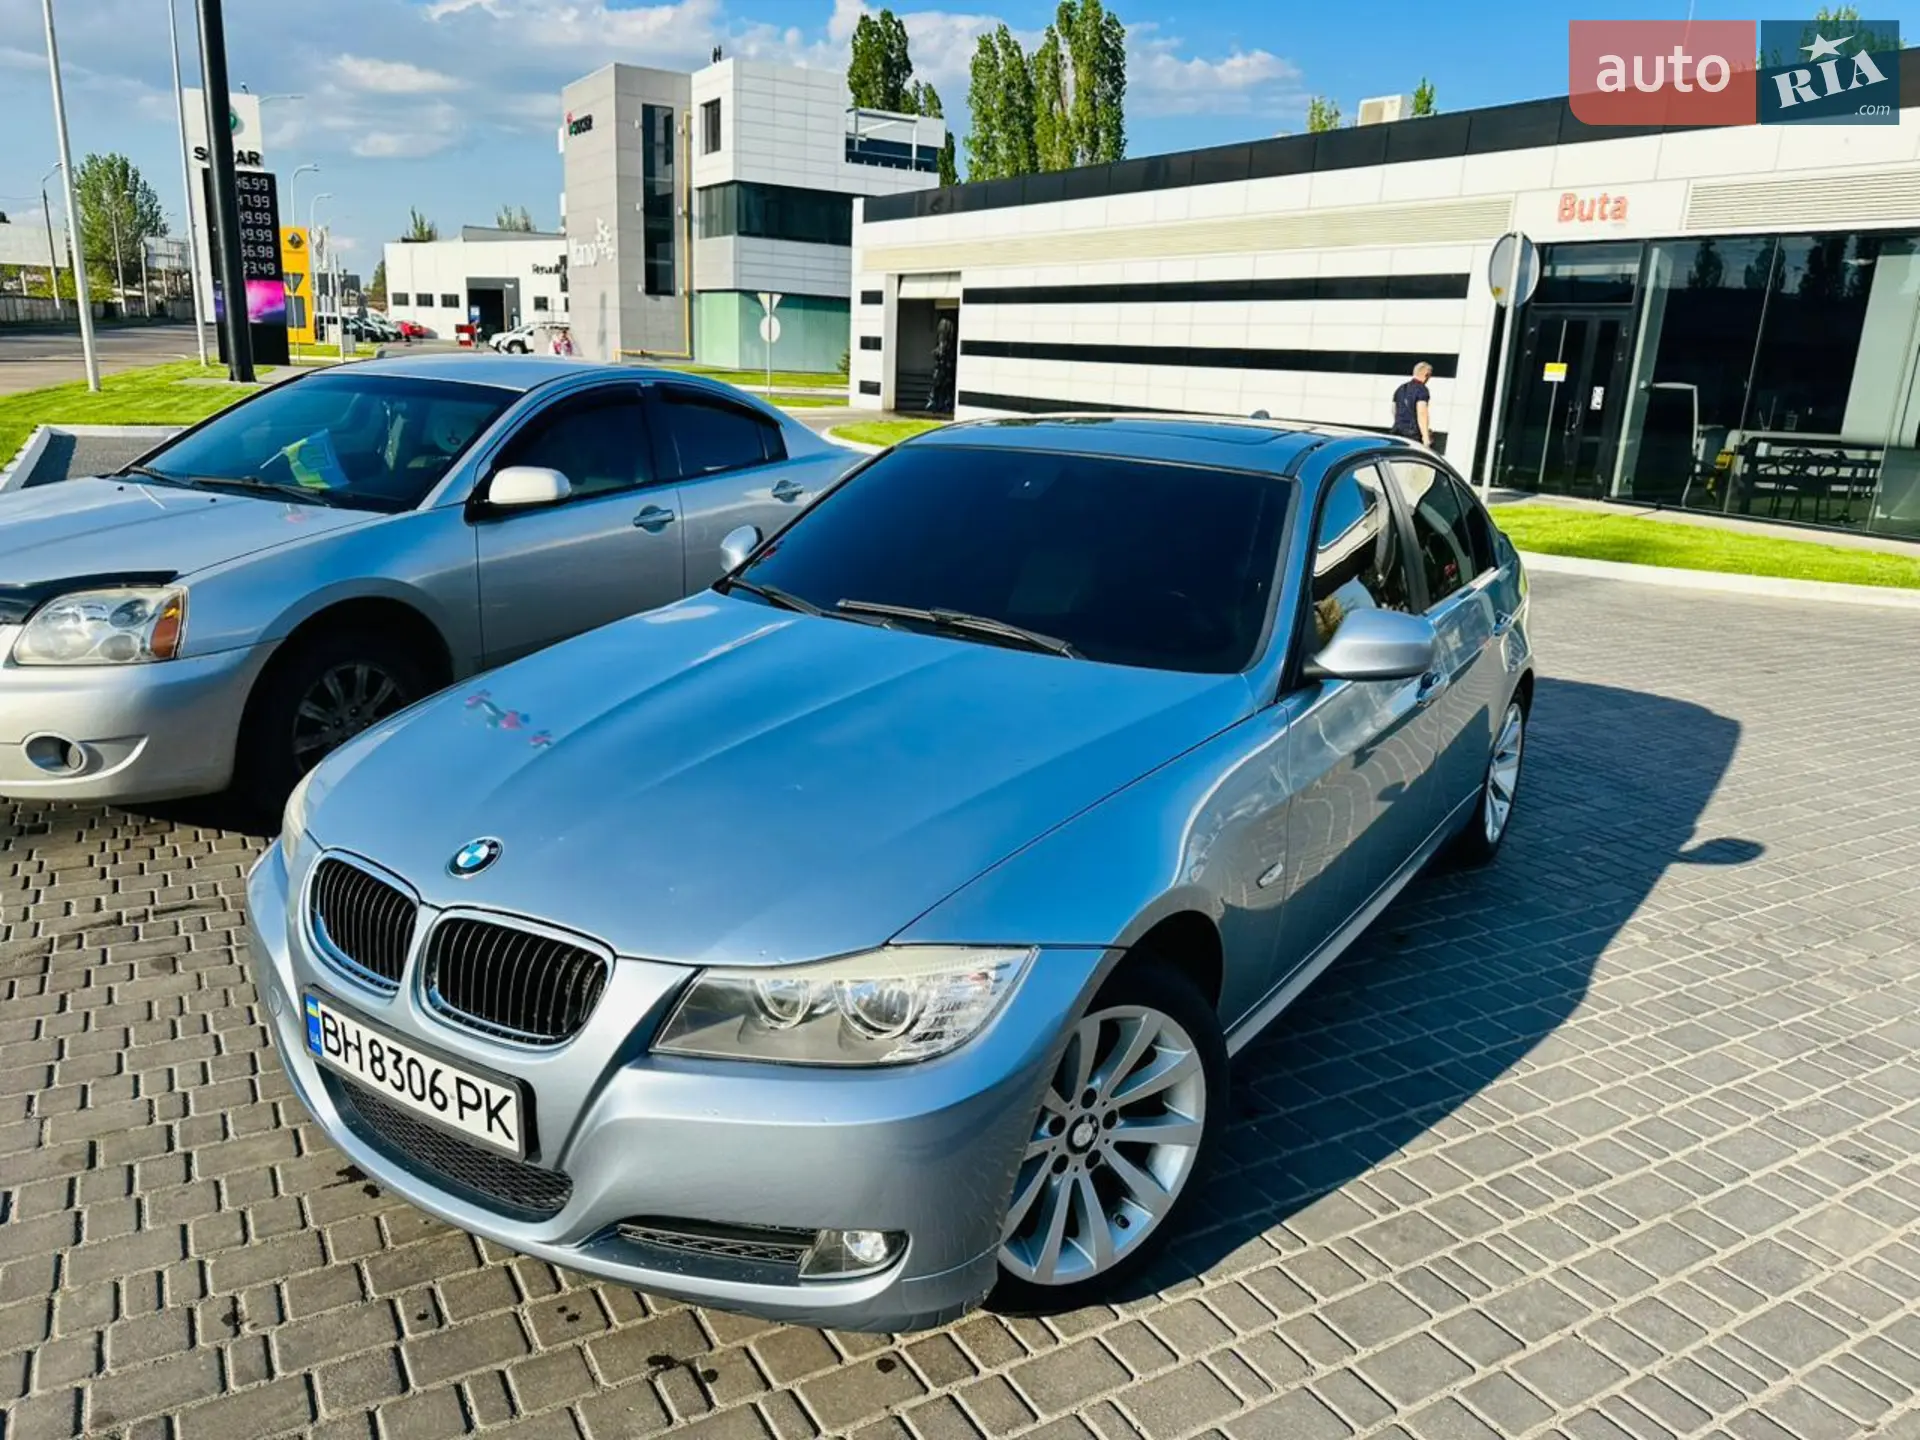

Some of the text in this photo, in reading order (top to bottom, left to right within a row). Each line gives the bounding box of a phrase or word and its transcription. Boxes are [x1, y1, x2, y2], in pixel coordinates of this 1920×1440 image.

[193, 146, 261, 166] SAR
[1558, 192, 1628, 222] Buta
[321, 1010, 515, 1142] BH 8306 PK
